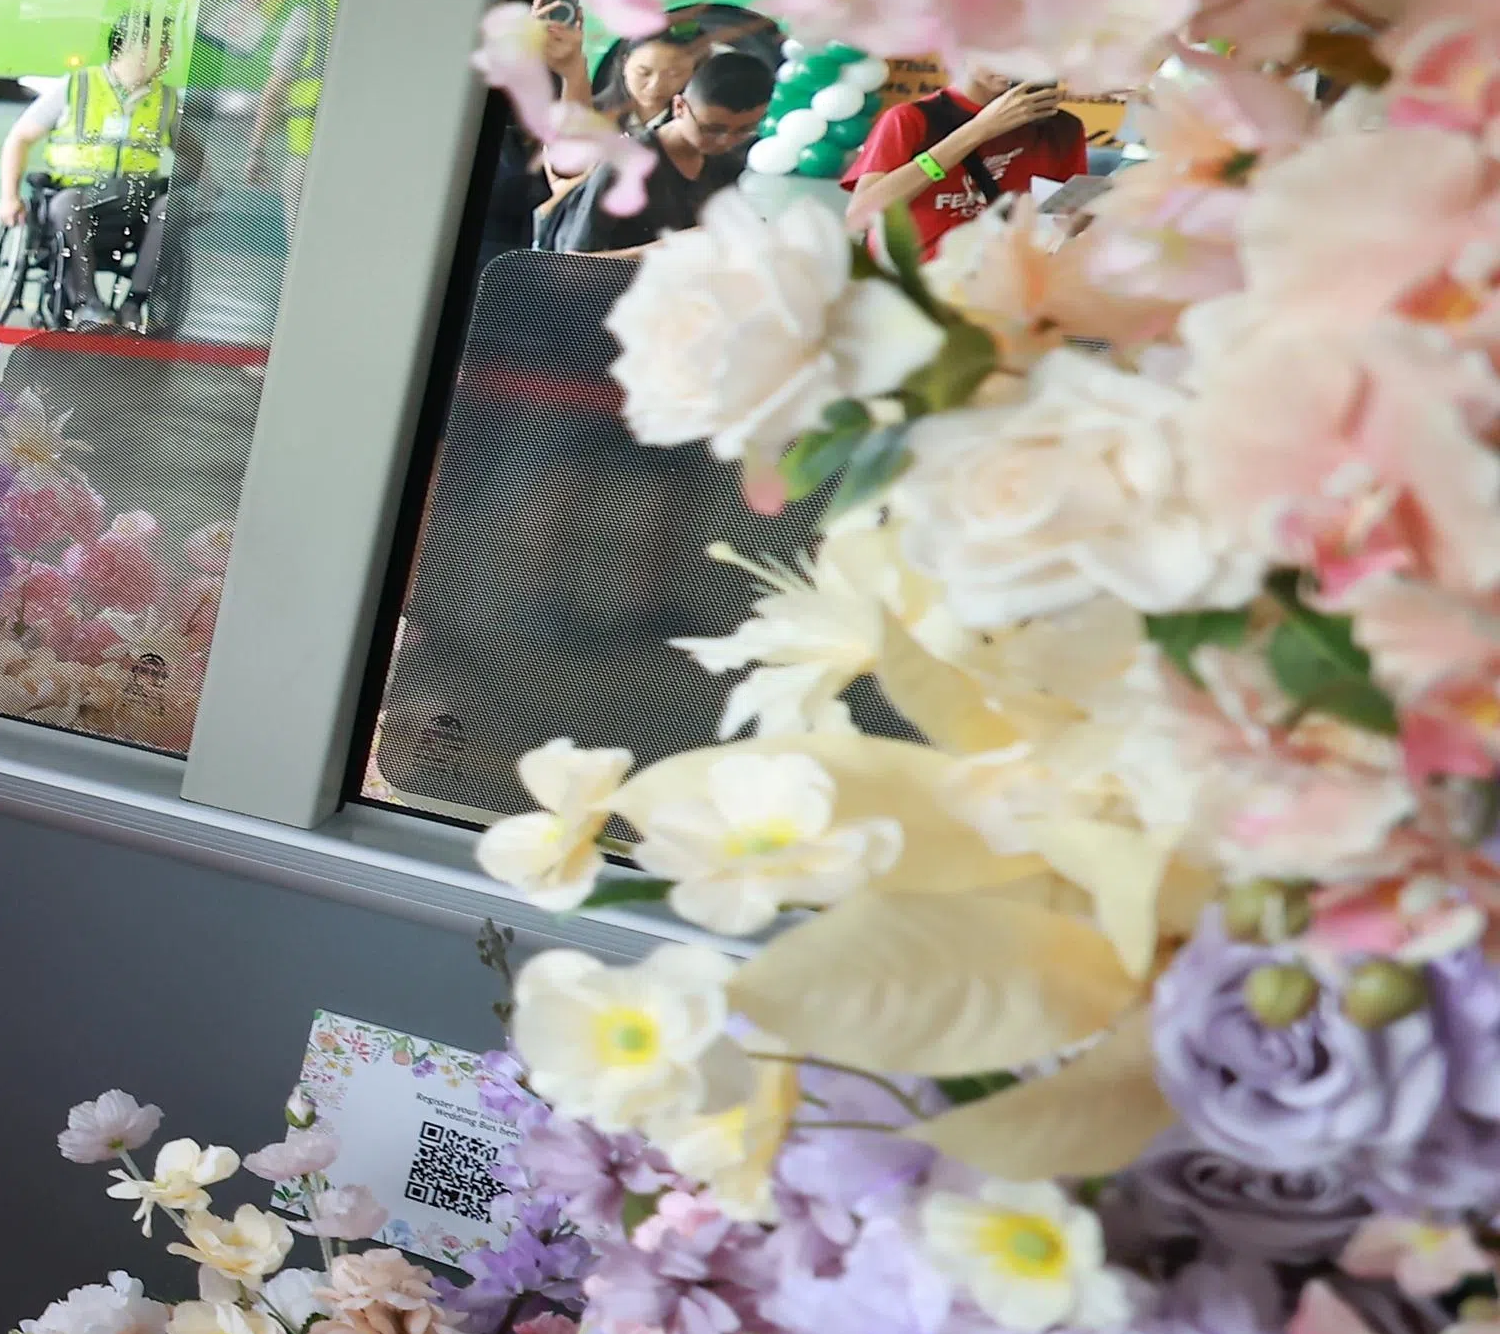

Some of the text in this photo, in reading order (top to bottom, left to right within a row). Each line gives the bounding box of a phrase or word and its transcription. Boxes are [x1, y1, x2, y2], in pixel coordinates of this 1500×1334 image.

[415, 1091, 478, 1117] Register your
[435, 1108, 477, 1128] Wedding
[479, 1120, 496, 1132] Bus
